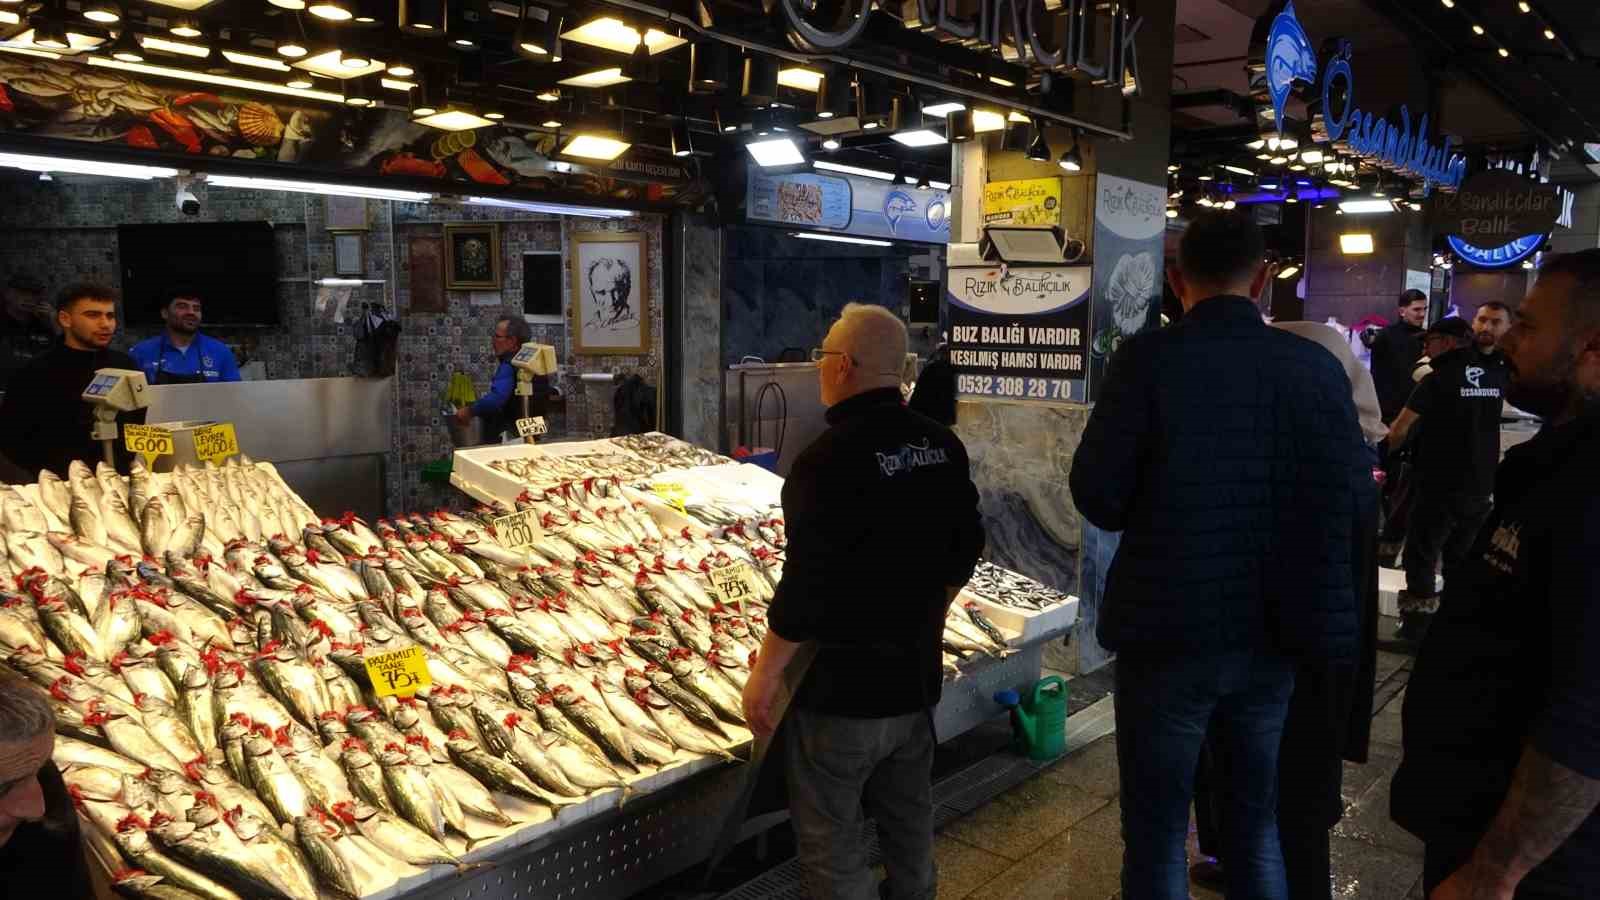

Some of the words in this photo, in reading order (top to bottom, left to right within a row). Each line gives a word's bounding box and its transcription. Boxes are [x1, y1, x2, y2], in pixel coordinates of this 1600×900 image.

[952, 325, 979, 344] BUZ
[981, 322, 1025, 345] BALIĞI
[1028, 327, 1081, 346] VARDIR
[1040, 354, 1082, 371] VARDIR
[958, 375, 993, 394] 0532
[996, 377, 1024, 396] 308
[1027, 379, 1047, 397] 28
[1051, 380, 1072, 399] 70
[505, 524, 533, 548] 100
